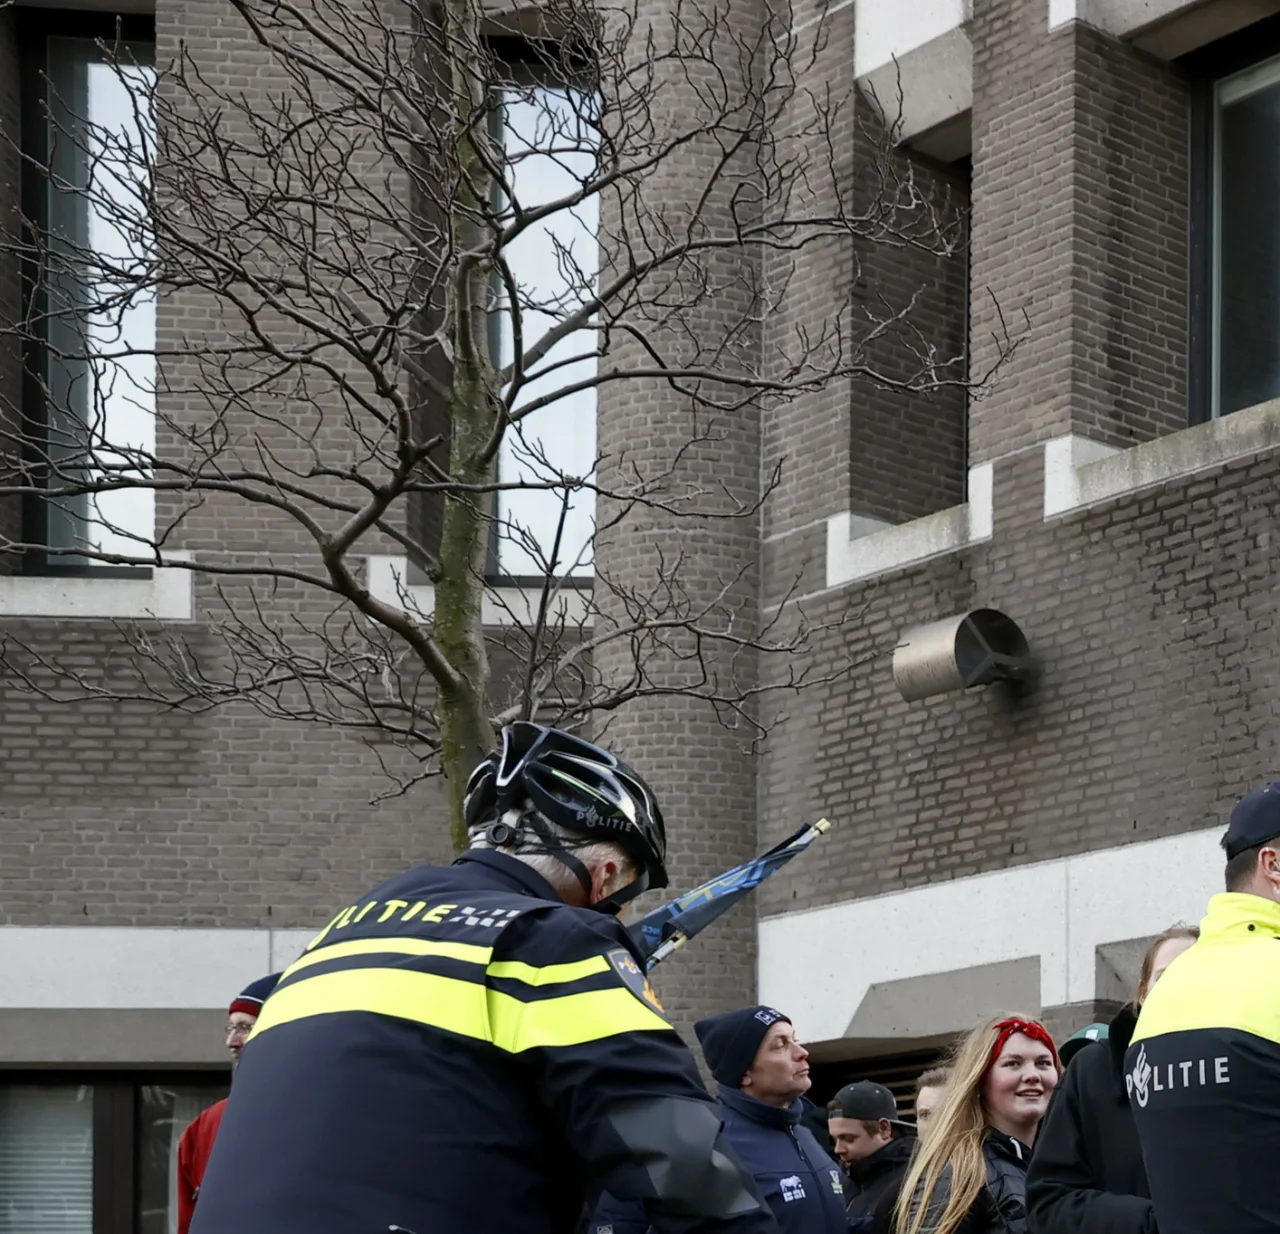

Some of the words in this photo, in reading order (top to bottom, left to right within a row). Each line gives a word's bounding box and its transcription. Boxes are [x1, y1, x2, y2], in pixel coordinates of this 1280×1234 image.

[576, 808, 633, 832] POLITIE
[306, 899, 459, 951] LITIE
[1125, 1048, 1231, 1108] POLITIE
